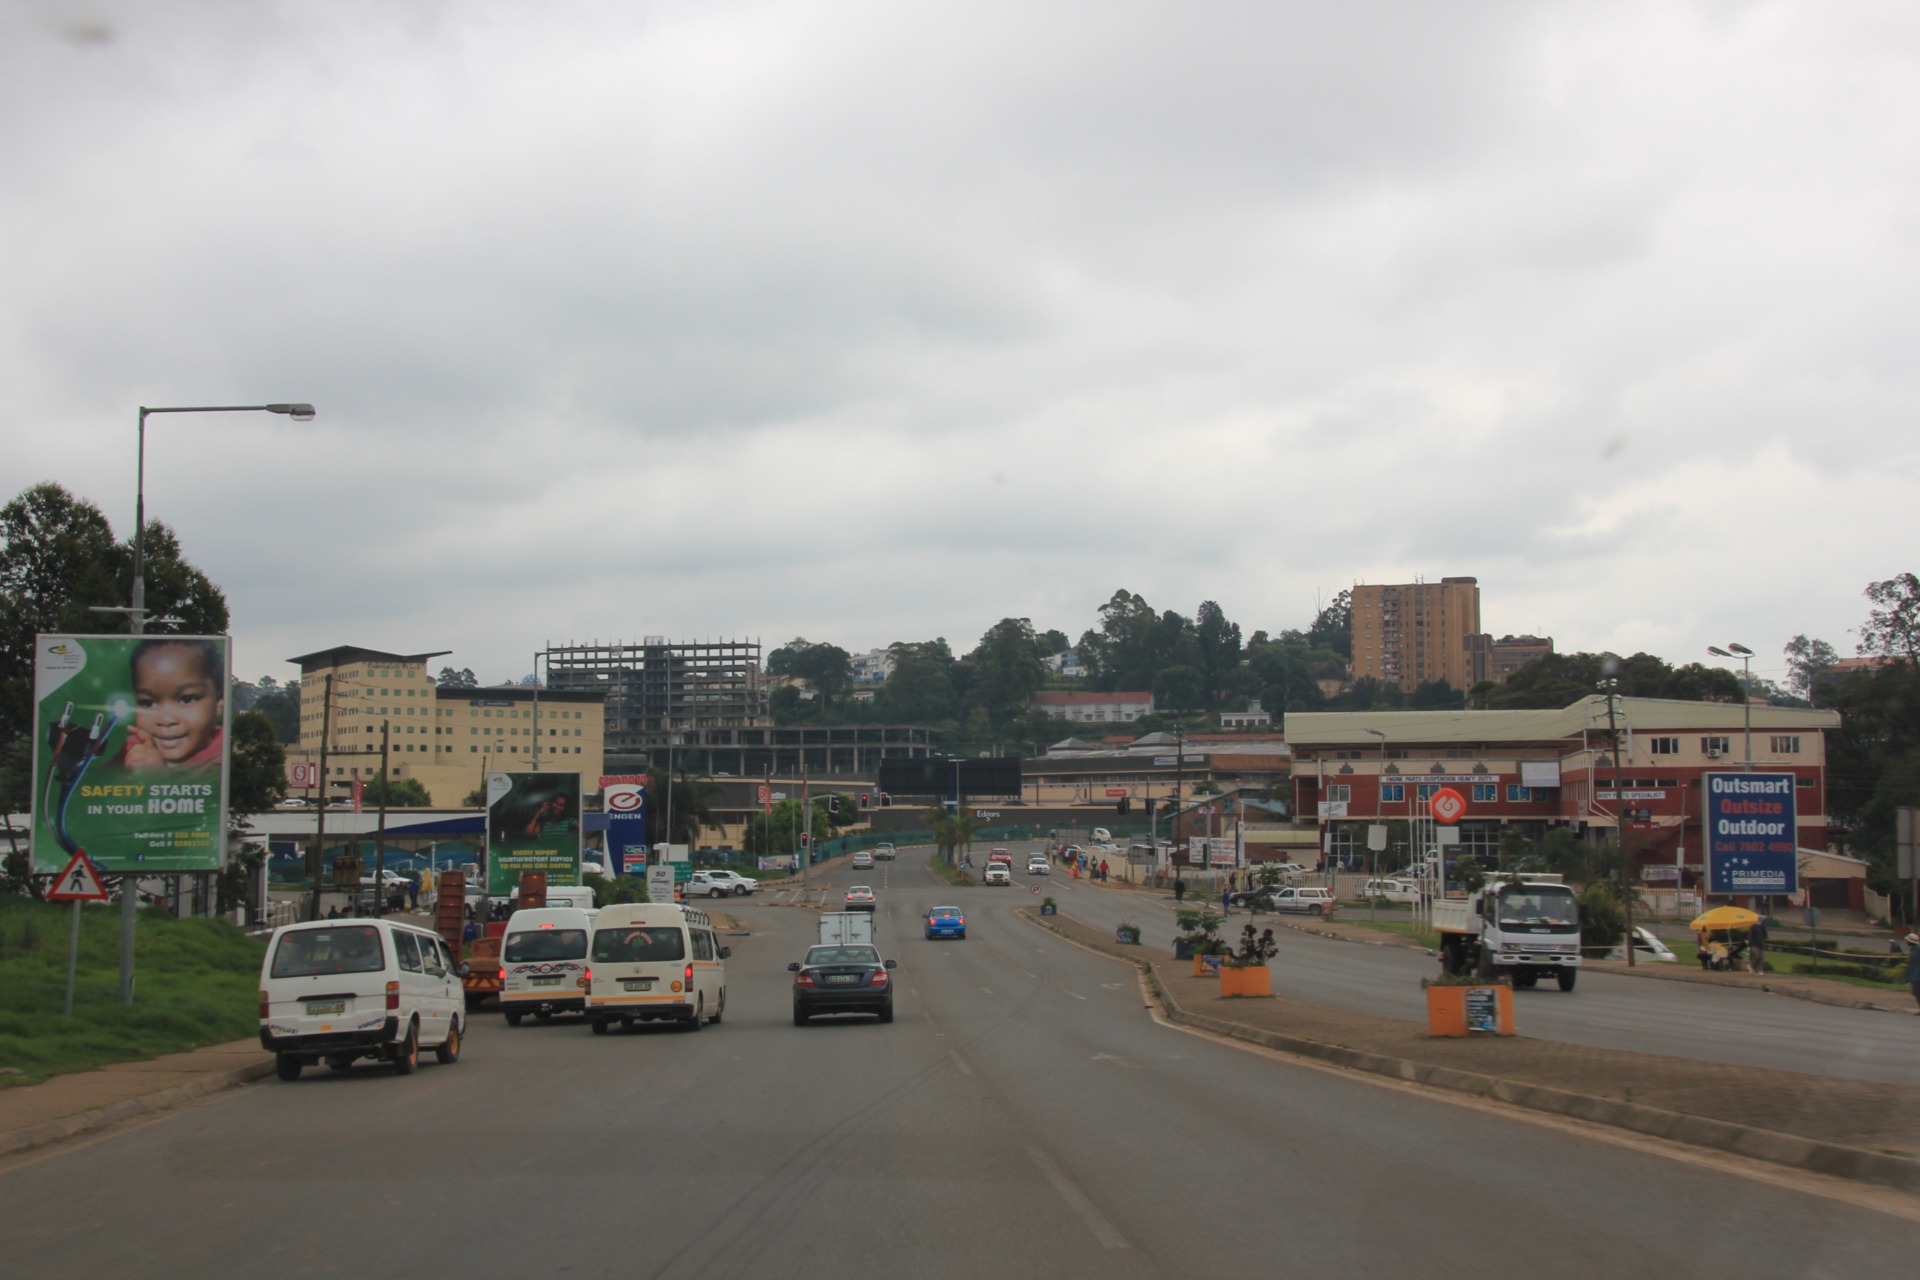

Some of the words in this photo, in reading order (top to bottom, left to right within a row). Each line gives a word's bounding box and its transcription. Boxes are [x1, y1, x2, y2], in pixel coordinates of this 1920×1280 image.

[81, 785, 145, 797] SAFETY
[149, 784, 212, 796] STARTS
[1712, 777, 1790, 793] Outsmart
[87, 805, 102, 815] IN
[106, 804, 144, 815] YOUR
[147, 799, 205, 815] HOME
[1721, 799, 1783, 814] Outsize
[976, 810, 1001, 822] Edgars
[1718, 819, 1785, 835] Outdoor
[1715, 841, 1736, 852] Call
[1731, 870, 1786, 878] PRIMEDIA
